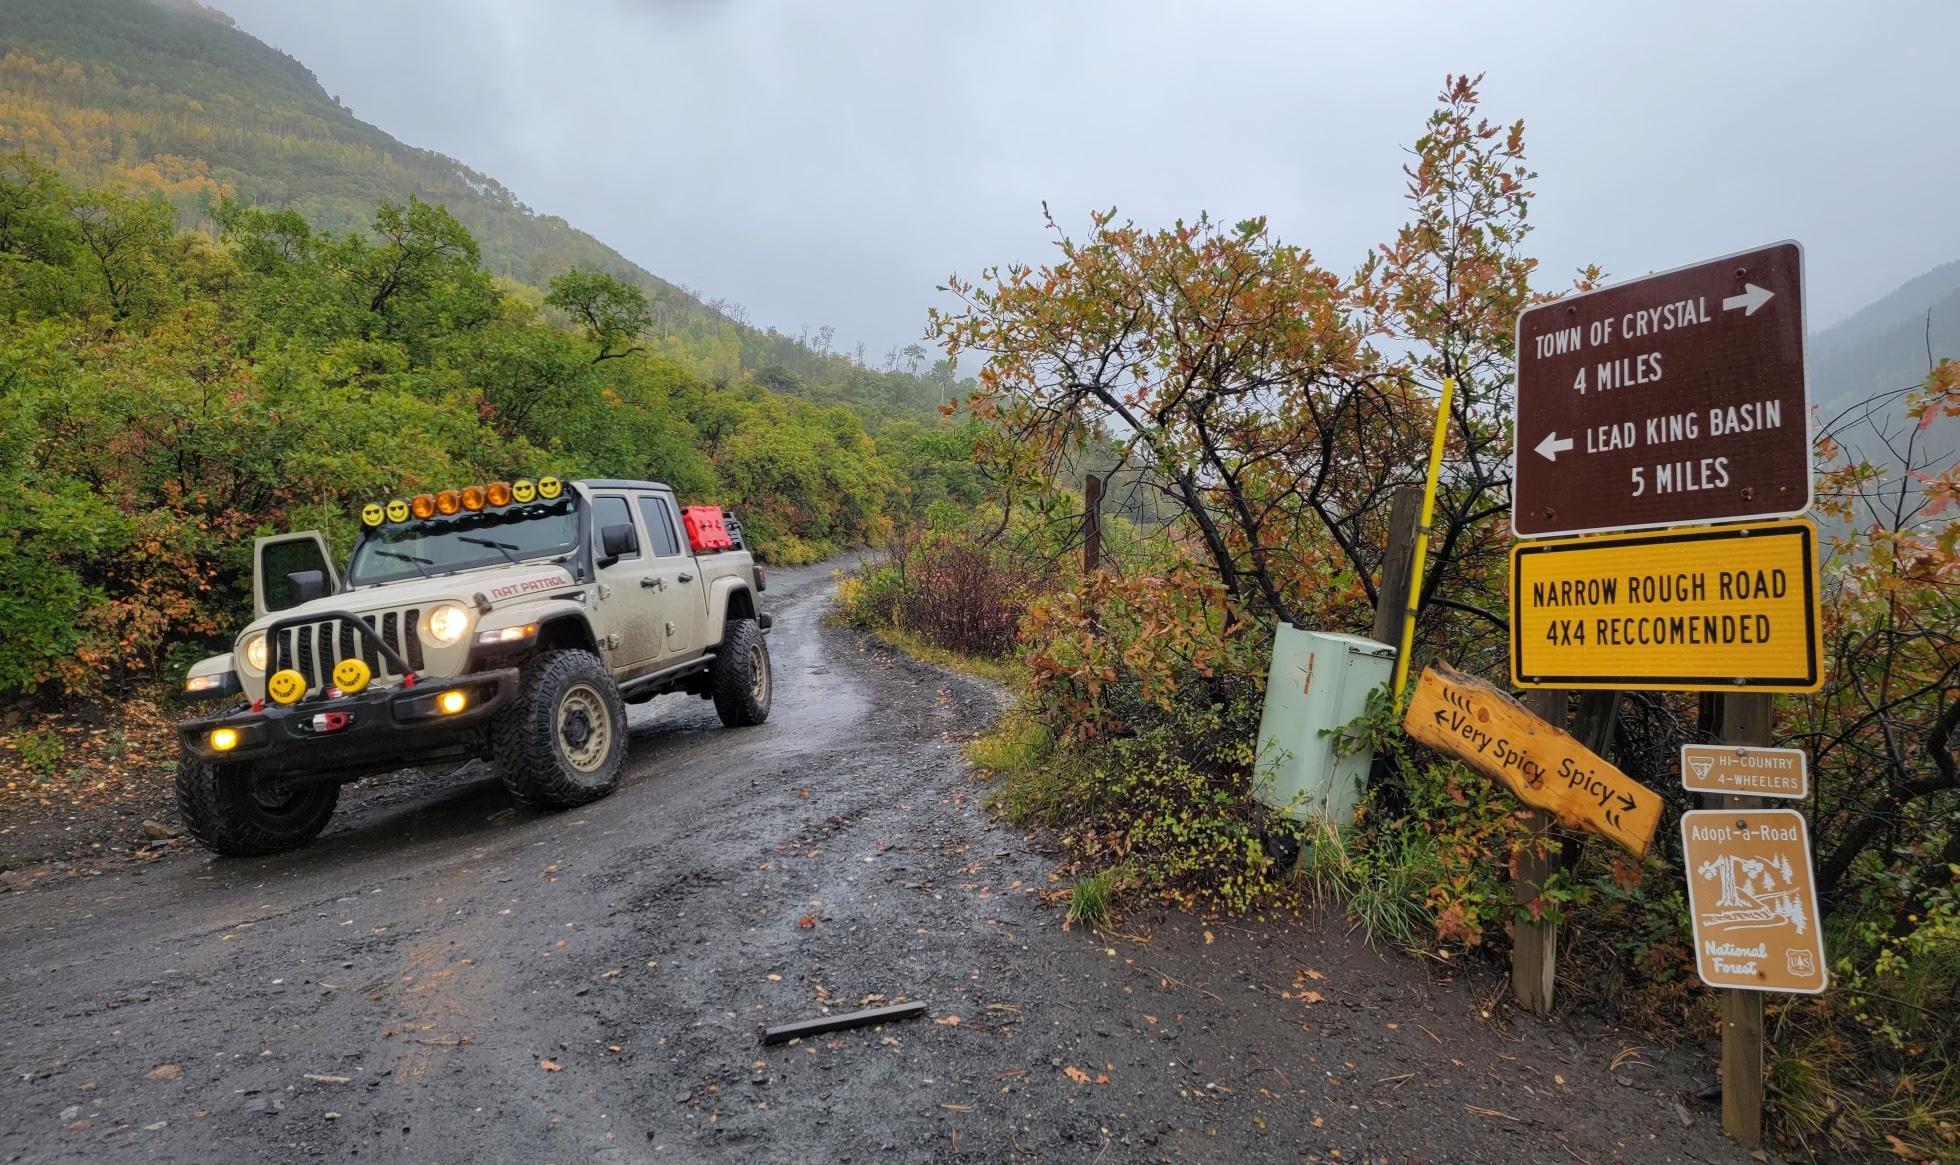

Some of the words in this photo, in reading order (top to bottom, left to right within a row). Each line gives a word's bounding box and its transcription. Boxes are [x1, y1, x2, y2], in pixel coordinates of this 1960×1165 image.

[1536, 326, 1581, 359] TOWN
[1590, 318, 1612, 346] OF
[1622, 296, 1711, 339] CRYSTAL
[1573, 367, 1586, 394] 4
[1597, 352, 1662, 391] MILES
[1587, 422, 1635, 453] LEAD
[1646, 412, 1698, 445] KING
[1710, 399, 1781, 437] BASIN
[1631, 467, 1644, 497] 5
[1656, 457, 1729, 494] MILES
[491, 584, 520, 598] RAT
[521, 576, 567, 592] PATROL
[1533, 577, 1617, 607] NARROW
[1628, 573, 1705, 604] ROUGH
[1719, 569, 1787, 600] ROAD
[1546, 619, 1585, 646] 4X4
[1596, 614, 1770, 646] RECCOMENDED
[1450, 711, 1492, 753] Very
[1493, 738, 1546, 784] Spicy
[1719, 755, 1793, 770] HI-COUNTRY
[1557, 757, 1615, 807] Spicy
[1717, 774, 1798, 789] 4-WHEELERS
[1692, 825, 1797, 844] Adopt-a-Road
[1704, 940, 1767, 959] National
[1712, 957, 1757, 975] Forest
